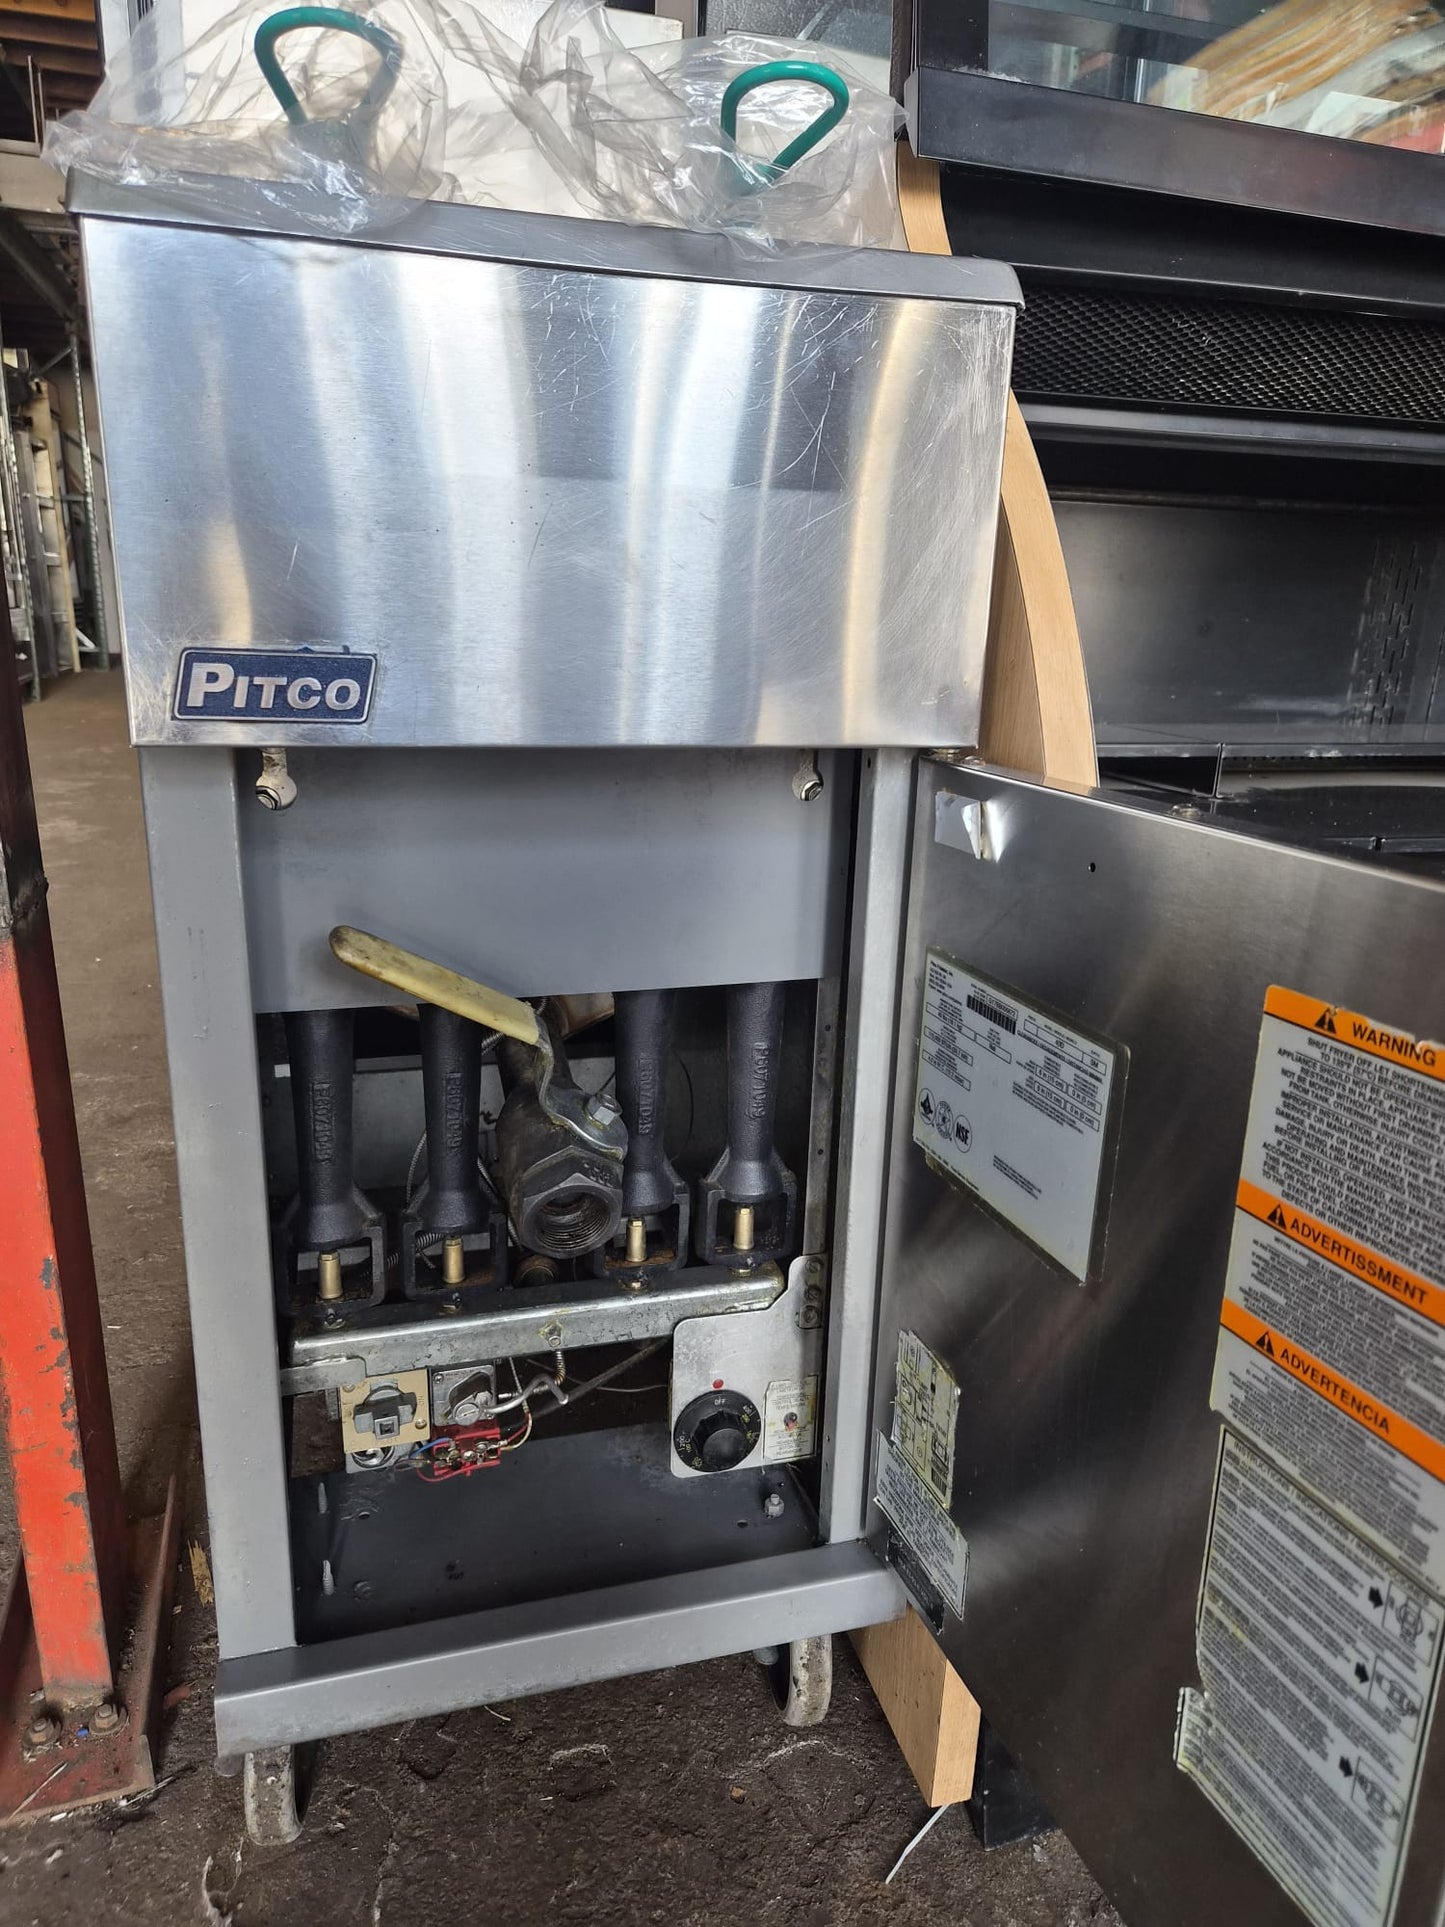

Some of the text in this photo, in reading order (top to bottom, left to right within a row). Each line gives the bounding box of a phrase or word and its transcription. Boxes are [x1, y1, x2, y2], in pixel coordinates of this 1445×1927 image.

[186, 662, 361, 710] PITCO
[1353, 1021, 1436, 1067] WARNING
[1290, 1215, 1428, 1305] ADVERTISSMENT
[1280, 1346, 1390, 1434] ADVERTENCIA
